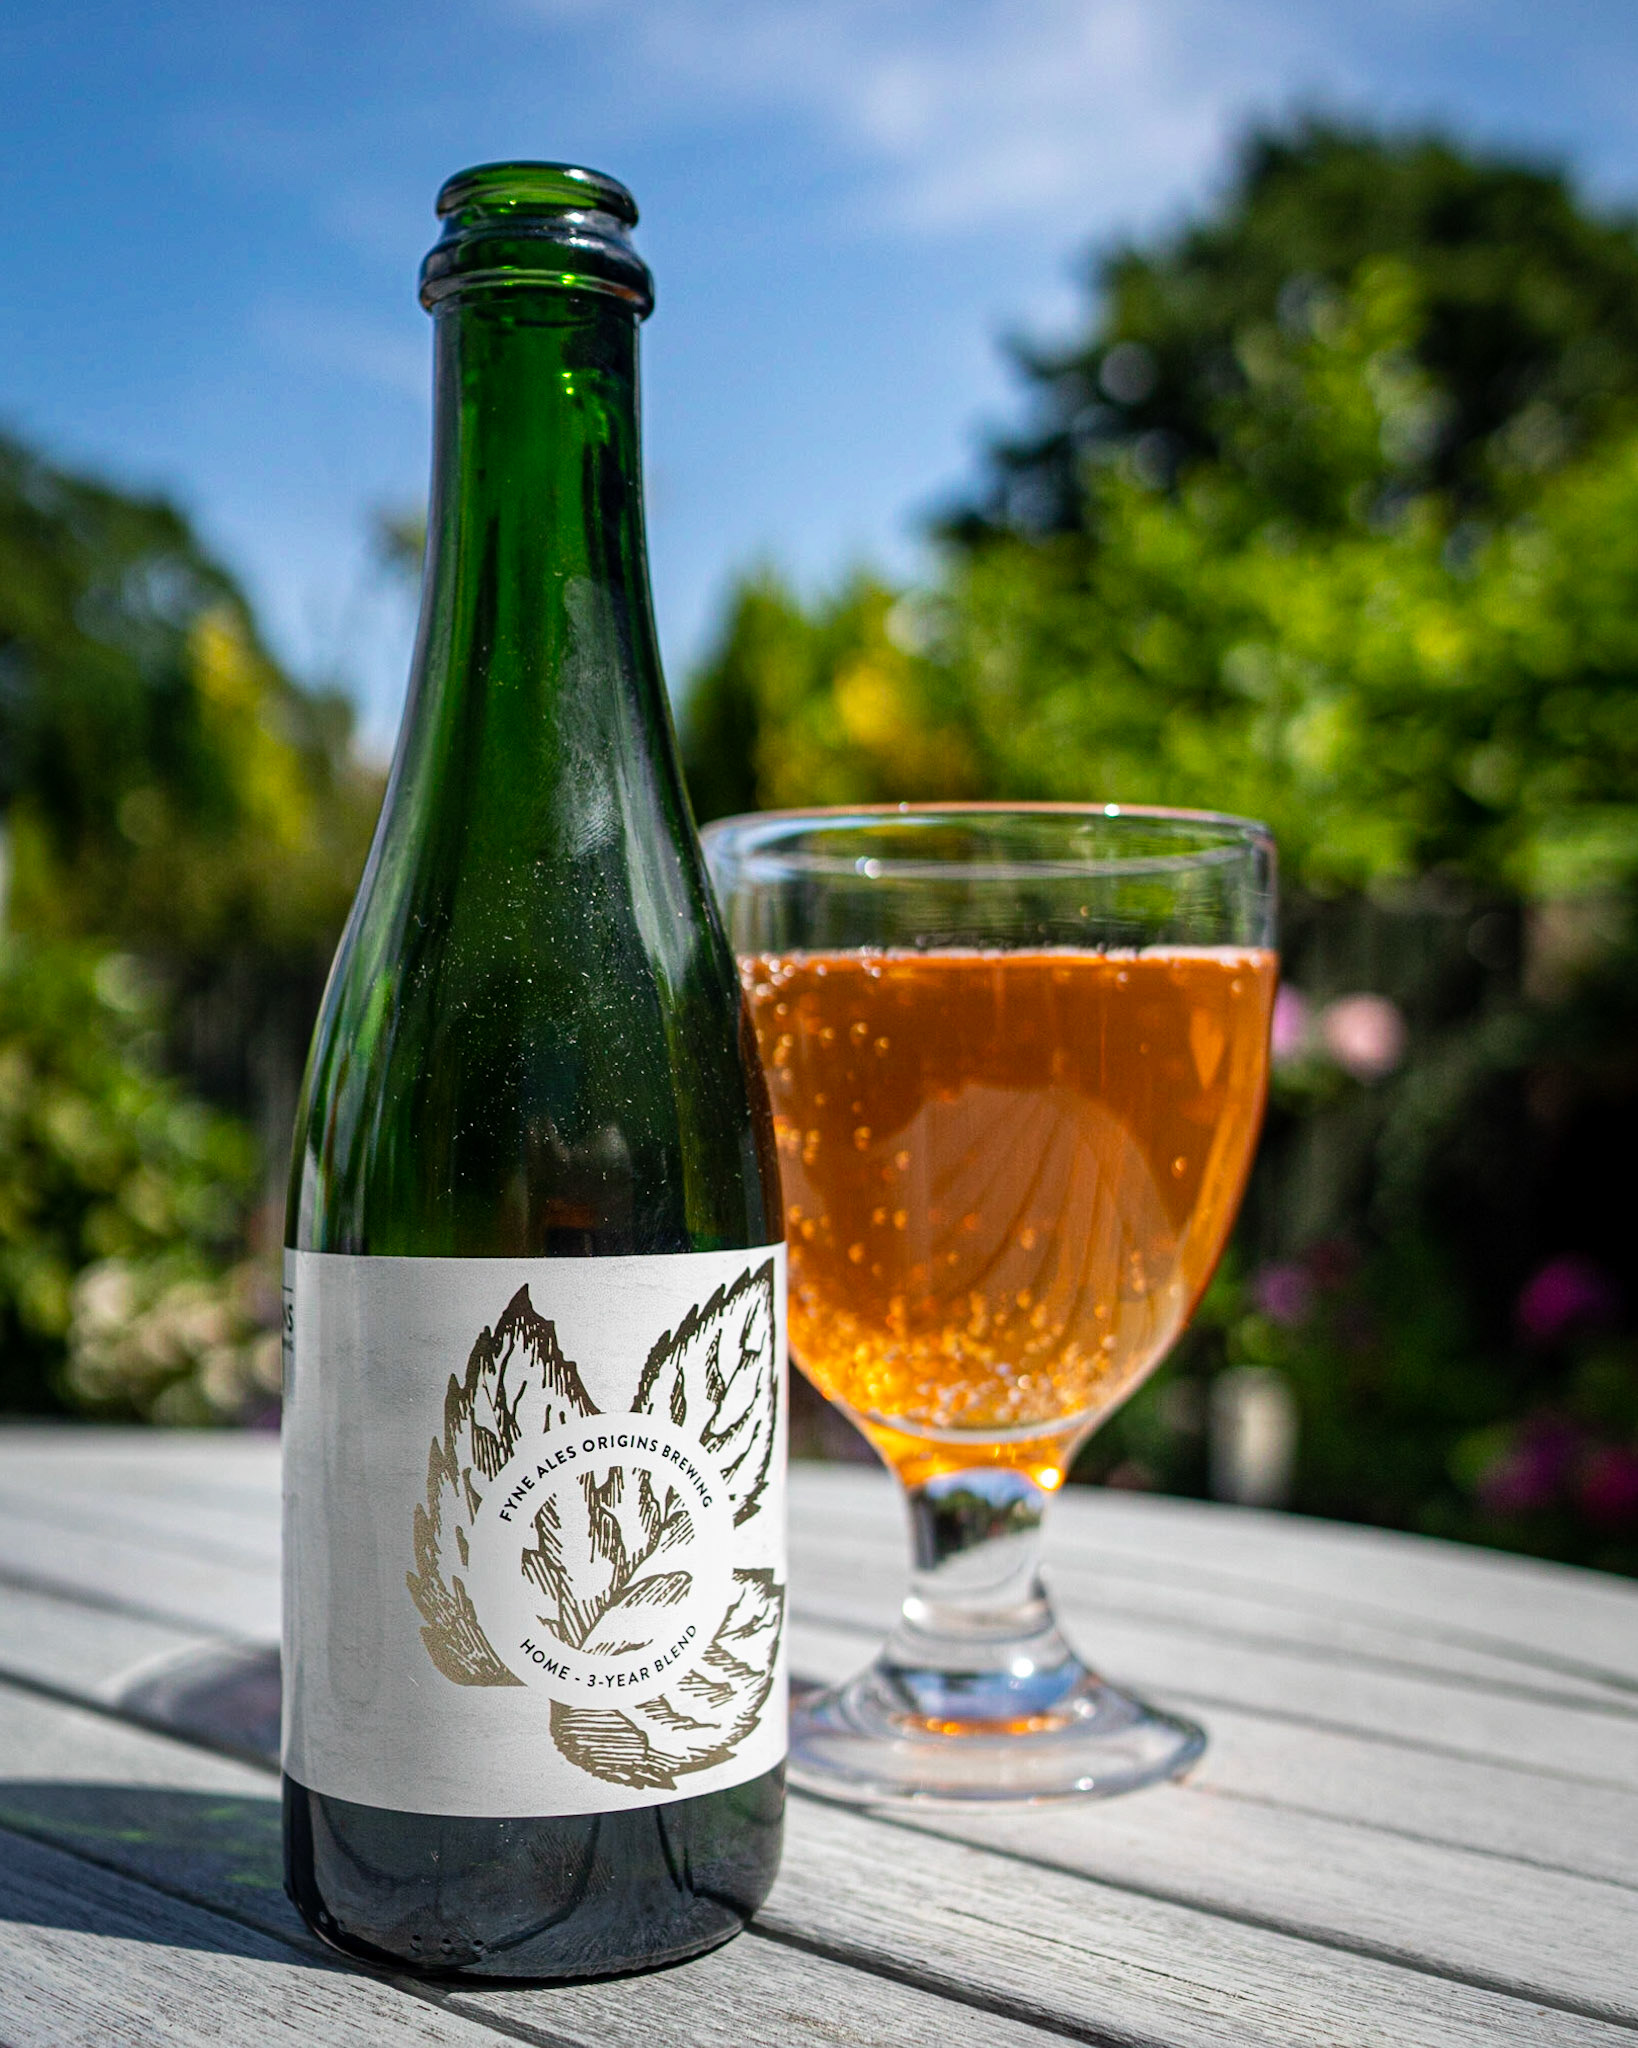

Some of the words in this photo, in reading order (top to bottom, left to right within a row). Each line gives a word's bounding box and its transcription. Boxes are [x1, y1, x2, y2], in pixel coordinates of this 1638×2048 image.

[500, 1476, 535, 1522] FYNE
[536, 1446, 577, 1478] ALES
[582, 1435, 658, 1453] ORIGINS
[661, 1446, 713, 1508] BREWING
[520, 1638, 570, 1680] HOME
[587, 1667, 650, 1688] 3-YEAR
[654, 1625, 697, 1673] BLEND
